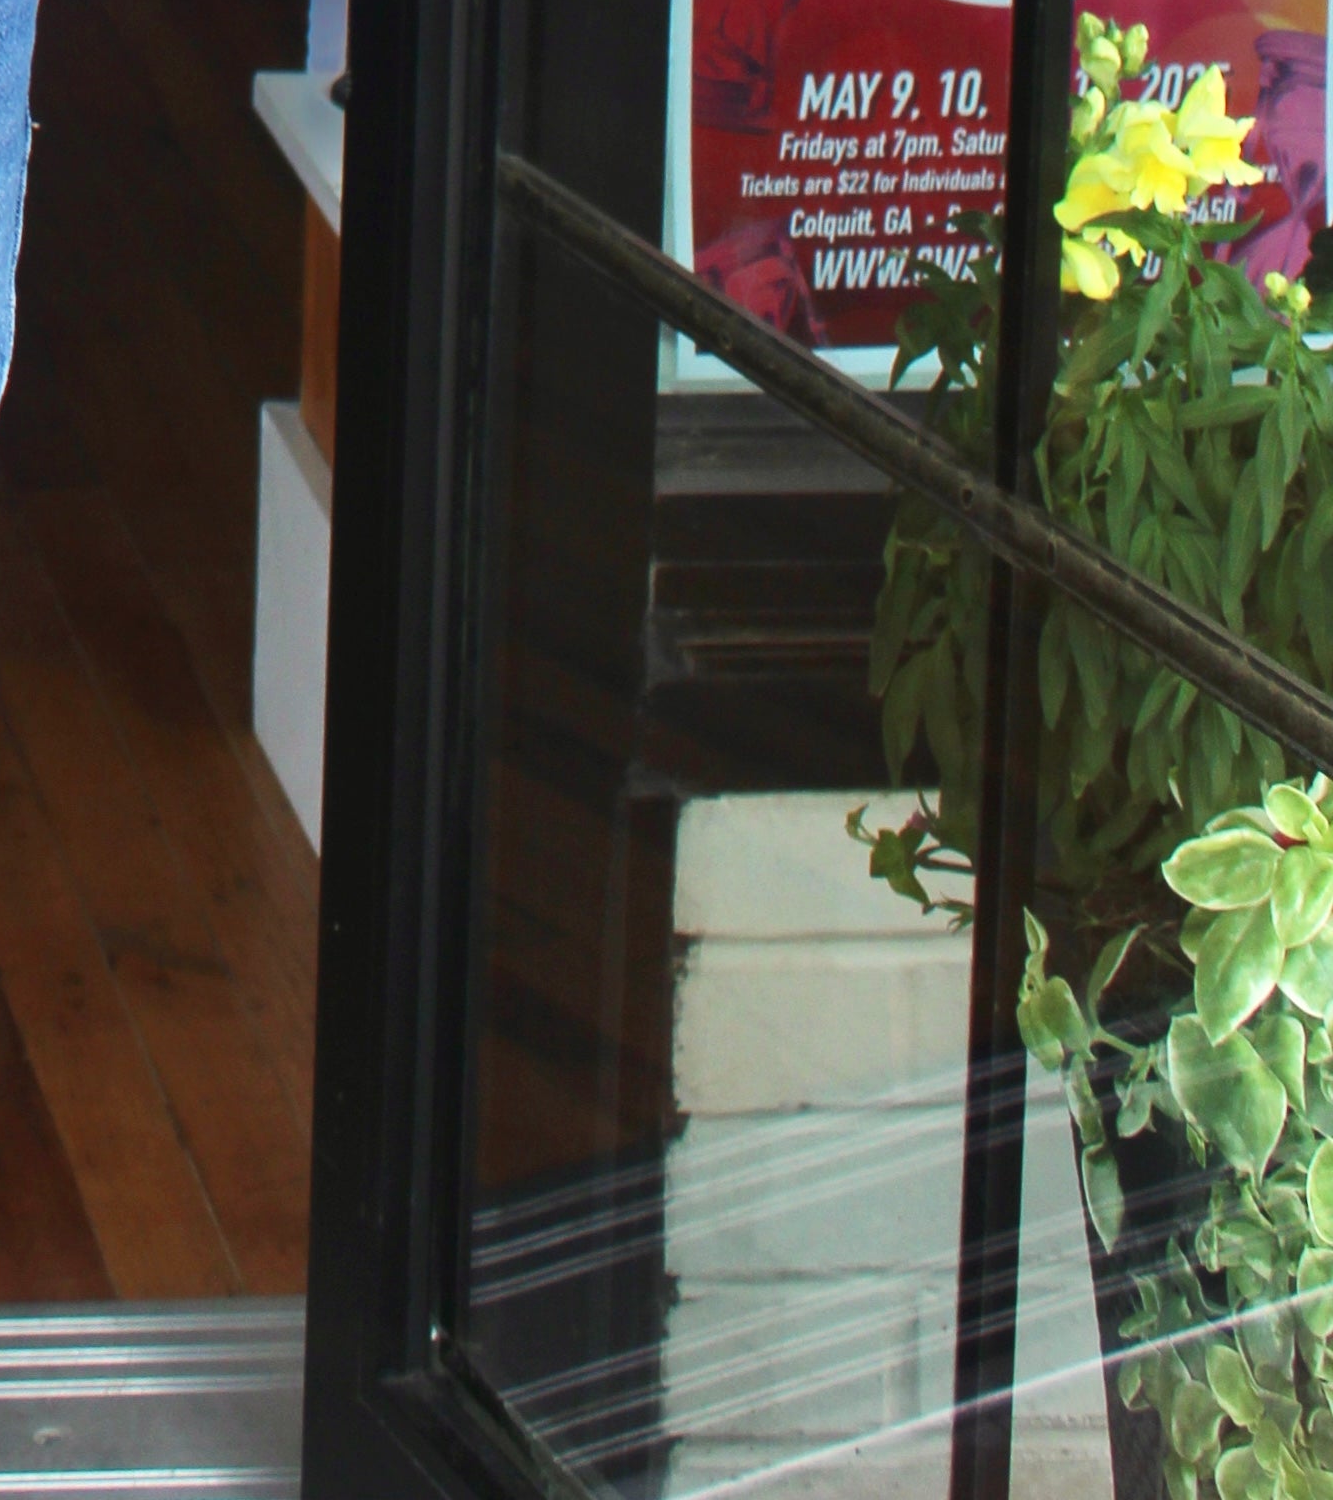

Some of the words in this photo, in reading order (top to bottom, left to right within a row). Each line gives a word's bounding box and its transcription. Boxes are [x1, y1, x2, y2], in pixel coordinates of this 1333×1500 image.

[798, 71, 883, 122] MAY
[890, 69, 921, 122] 9,
[939, 67, 988, 120] 10,
[779, 130, 858, 167] Fridays
[864, 130, 887, 159] at
[891, 129, 944, 164] 7pm.
[740, 171, 800, 198] Tickets
[803, 175, 832, 195] are
[837, 168, 870, 195] $22
[874, 170, 897, 193] for
[902, 168, 995, 193] Individuals
[789, 206, 876, 244] Colquitt,
[883, 205, 913, 236] GA
